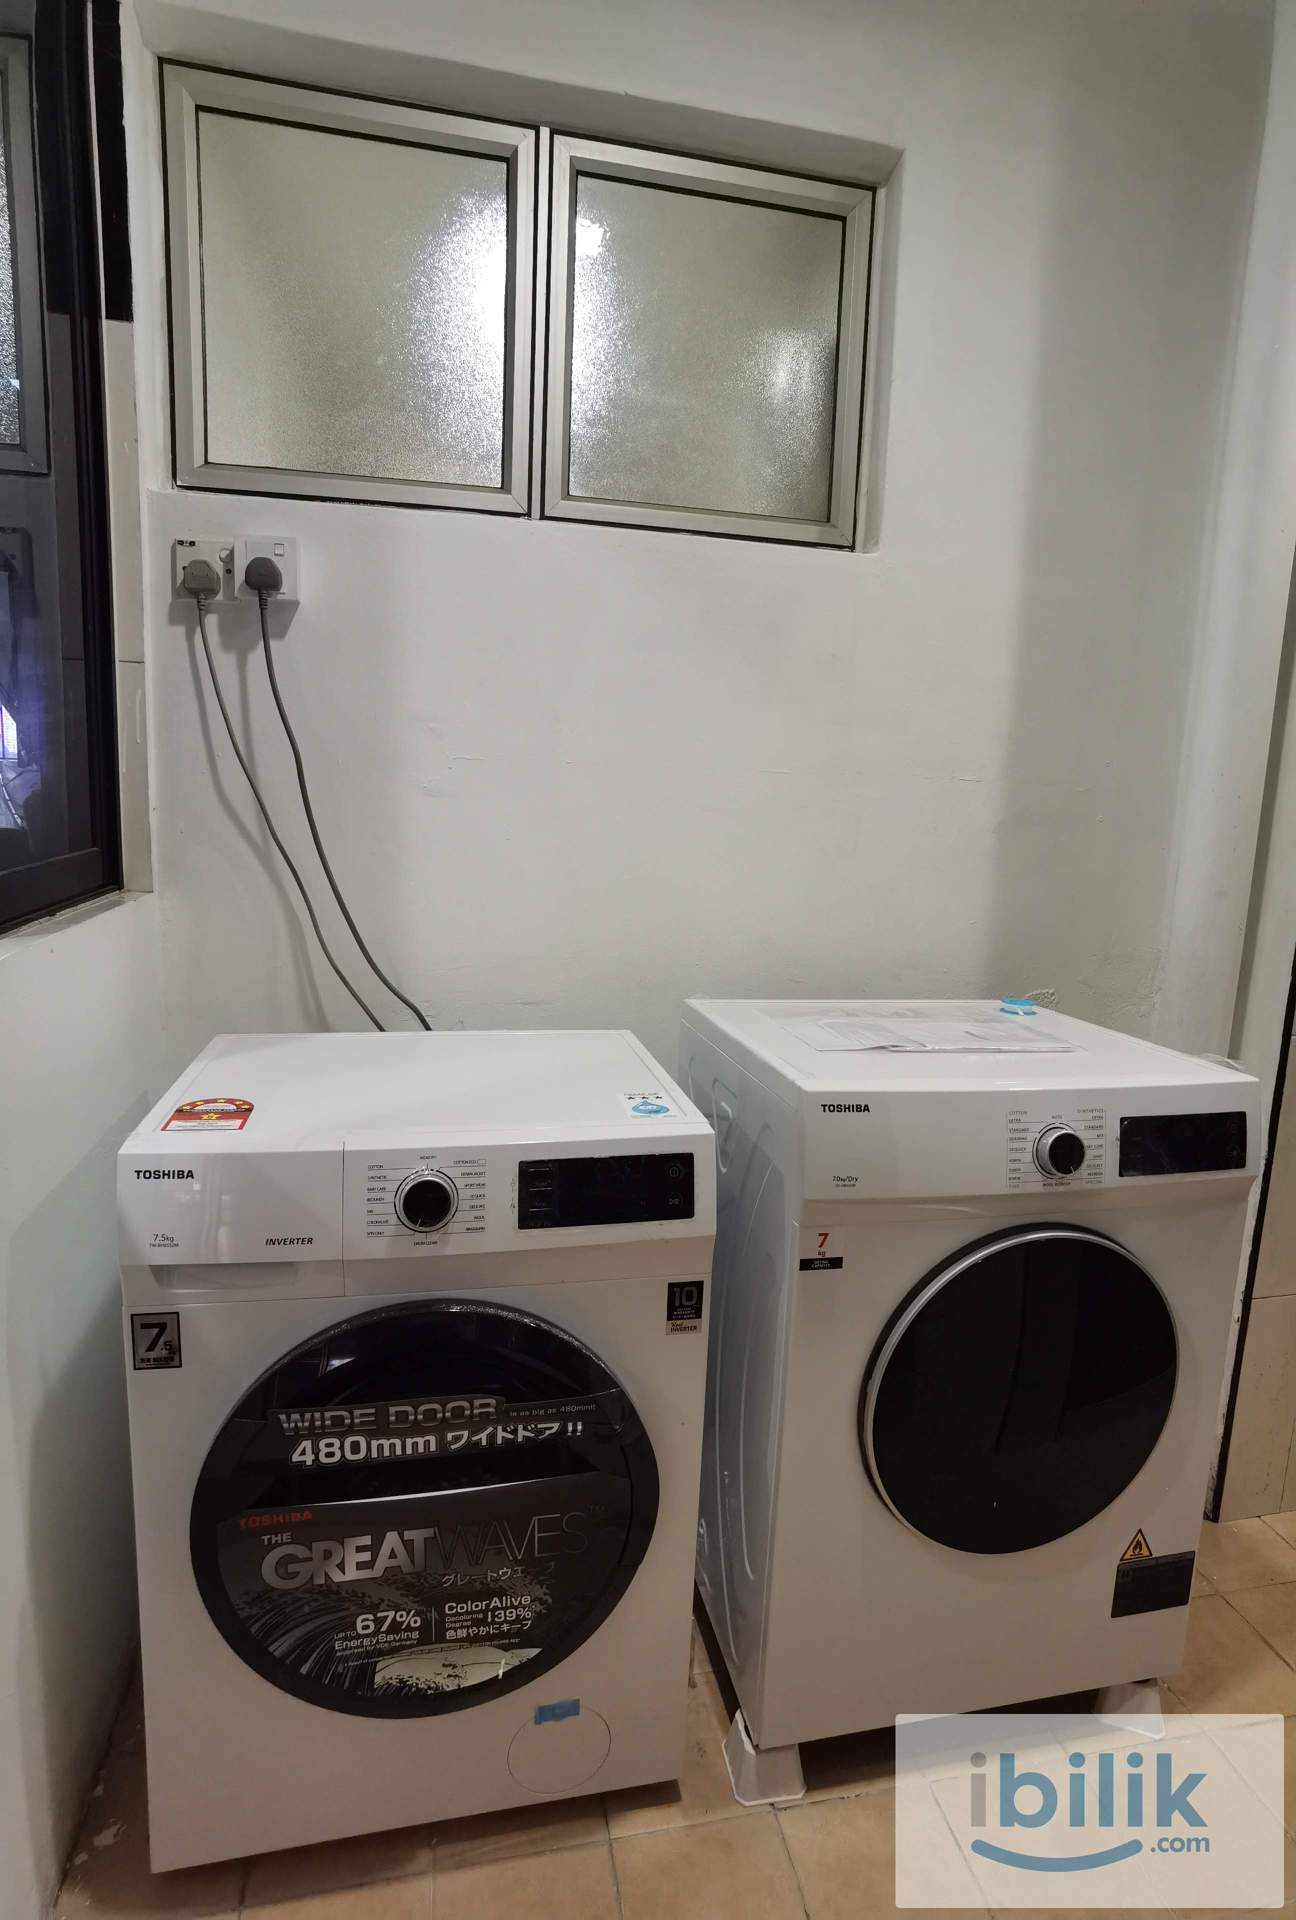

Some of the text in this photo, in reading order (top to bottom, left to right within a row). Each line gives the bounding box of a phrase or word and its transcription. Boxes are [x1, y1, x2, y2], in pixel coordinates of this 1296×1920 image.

[821, 1104, 870, 1113] TOSHIBA
[135, 1170, 194, 1180] TOSHIBA
[265, 1237, 314, 1246] INVERTER
[818, 1232, 829, 1248] 7
[674, 1286, 697, 1306] 10
[278, 1398, 497, 1436] WIDE DOOR
[291, 1435, 436, 1466] 480mm
[240, 1510, 312, 1529] TOSHIBA
[261, 1532, 293, 1545] THE
[445, 1595, 531, 1614] ColorAlive
[356, 1609, 421, 1634] 67%
[335, 1630, 420, 1650] EnergySaving
